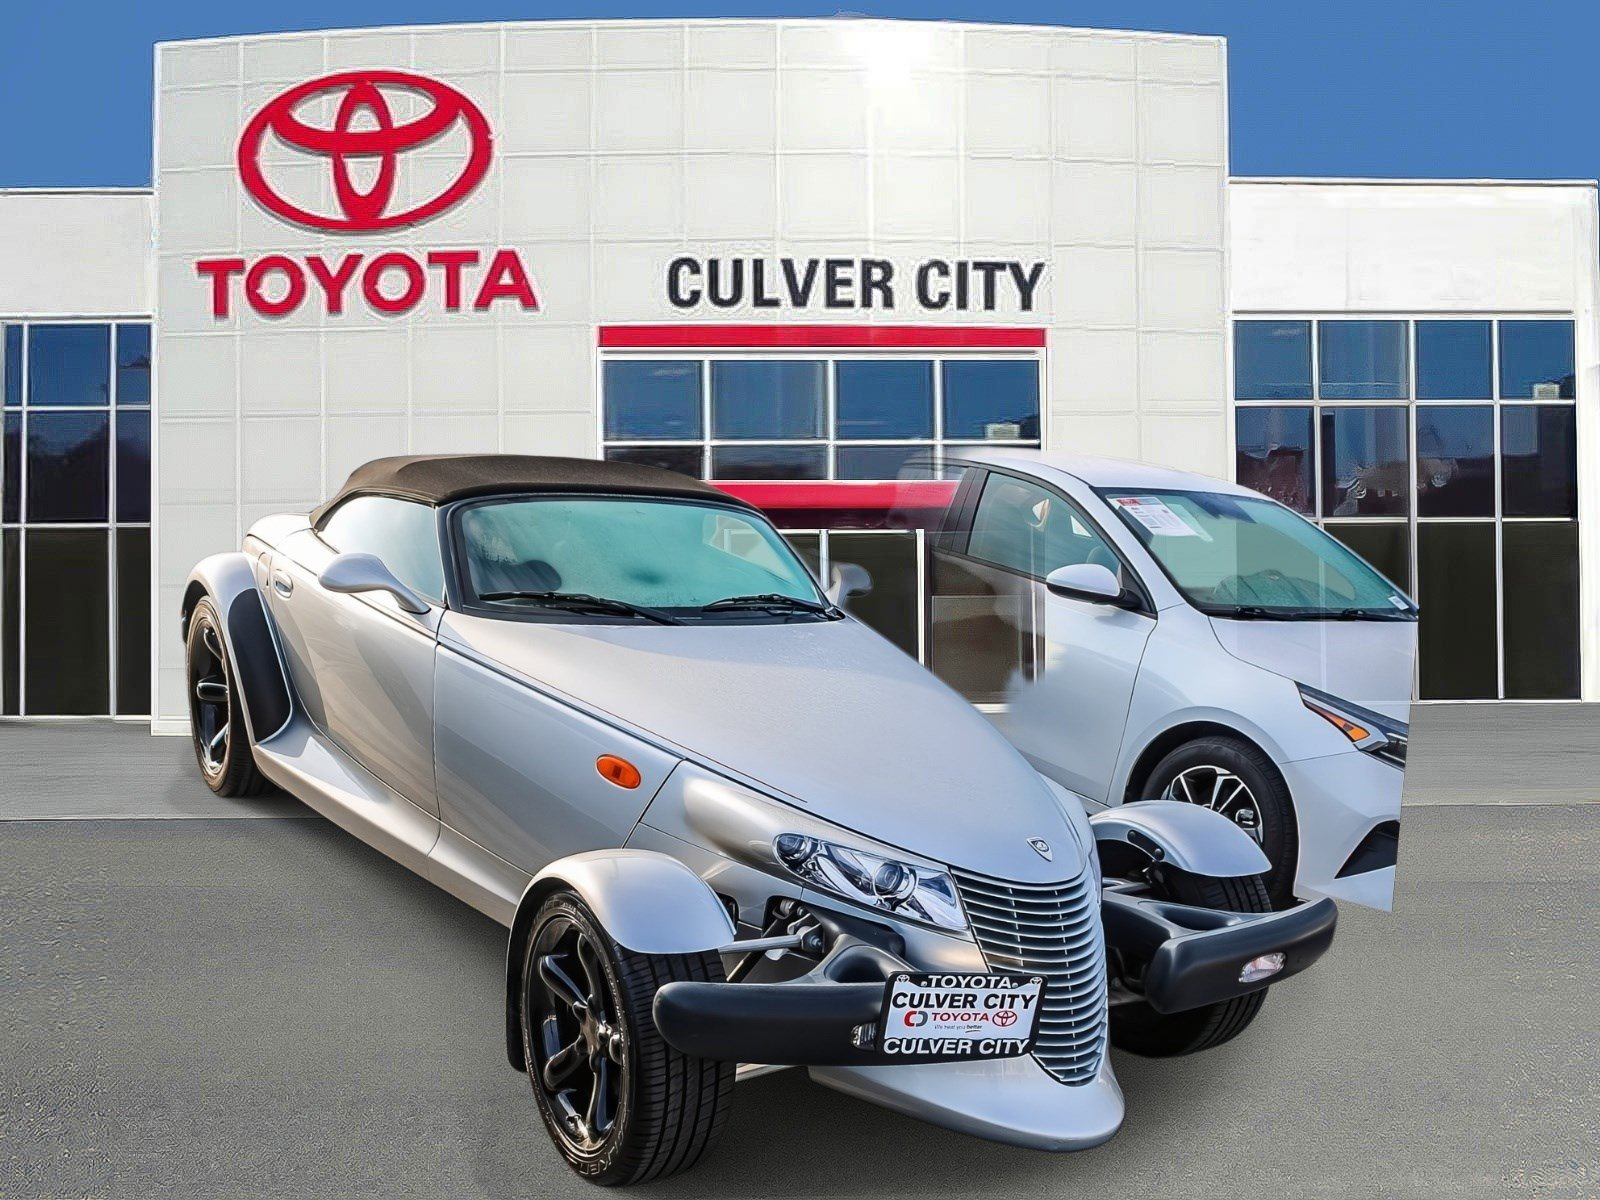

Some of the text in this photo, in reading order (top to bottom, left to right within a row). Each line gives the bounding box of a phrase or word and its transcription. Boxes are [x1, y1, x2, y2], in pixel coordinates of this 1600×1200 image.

[195, 249, 539, 318] TOYOTA
[667, 257, 1045, 311] CULVER CITY
[928, 975, 1011, 989] TOYOTA
[892, 992, 1037, 1010] CULVER CITY
[931, 1012, 989, 1022] TOYOTA
[883, 1038, 1030, 1055] CULVER CITY
